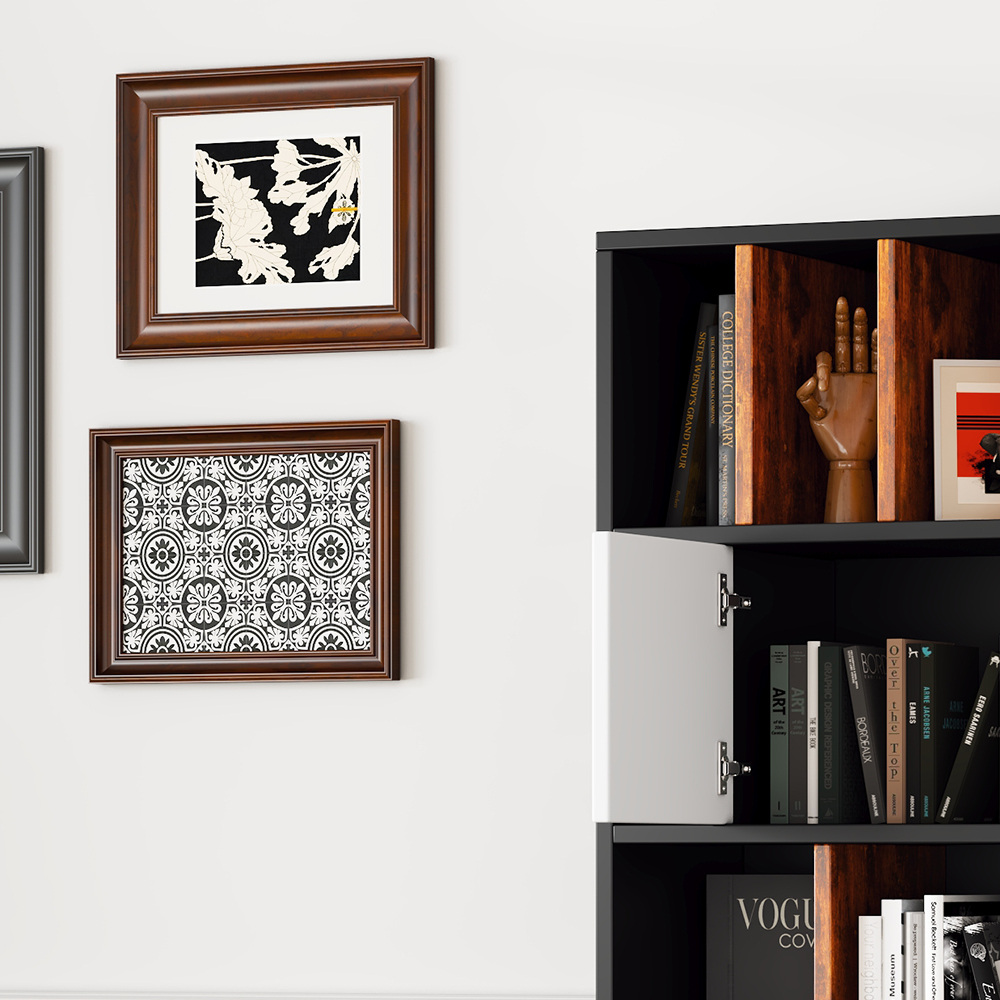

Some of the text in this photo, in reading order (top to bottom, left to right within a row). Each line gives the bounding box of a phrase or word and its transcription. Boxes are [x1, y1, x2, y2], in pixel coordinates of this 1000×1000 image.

[695, 332, 707, 362] SISTER
[688, 364, 702, 405] WENDY'S
[722, 312, 733, 448] COLLEGE DICTIONARY
[683, 407, 695, 440] GRAND
[678, 442, 690, 469] TOUR
[824, 662, 832, 699] GRAPHIC
[773, 687, 785, 715] ART
[792, 687, 804, 715] ART
[824, 702, 832, 732] DESIGN
[890, 645, 898, 779] Over the Top
[964, 695, 987, 746] EERO SAARINEN
[856, 717, 872, 763] BORDEAUX
[824, 735, 832, 789] REFERENCED
[737, 897, 814, 930] VOGU
[779, 933, 814, 948] COV
[889, 954, 897, 997] Museum
